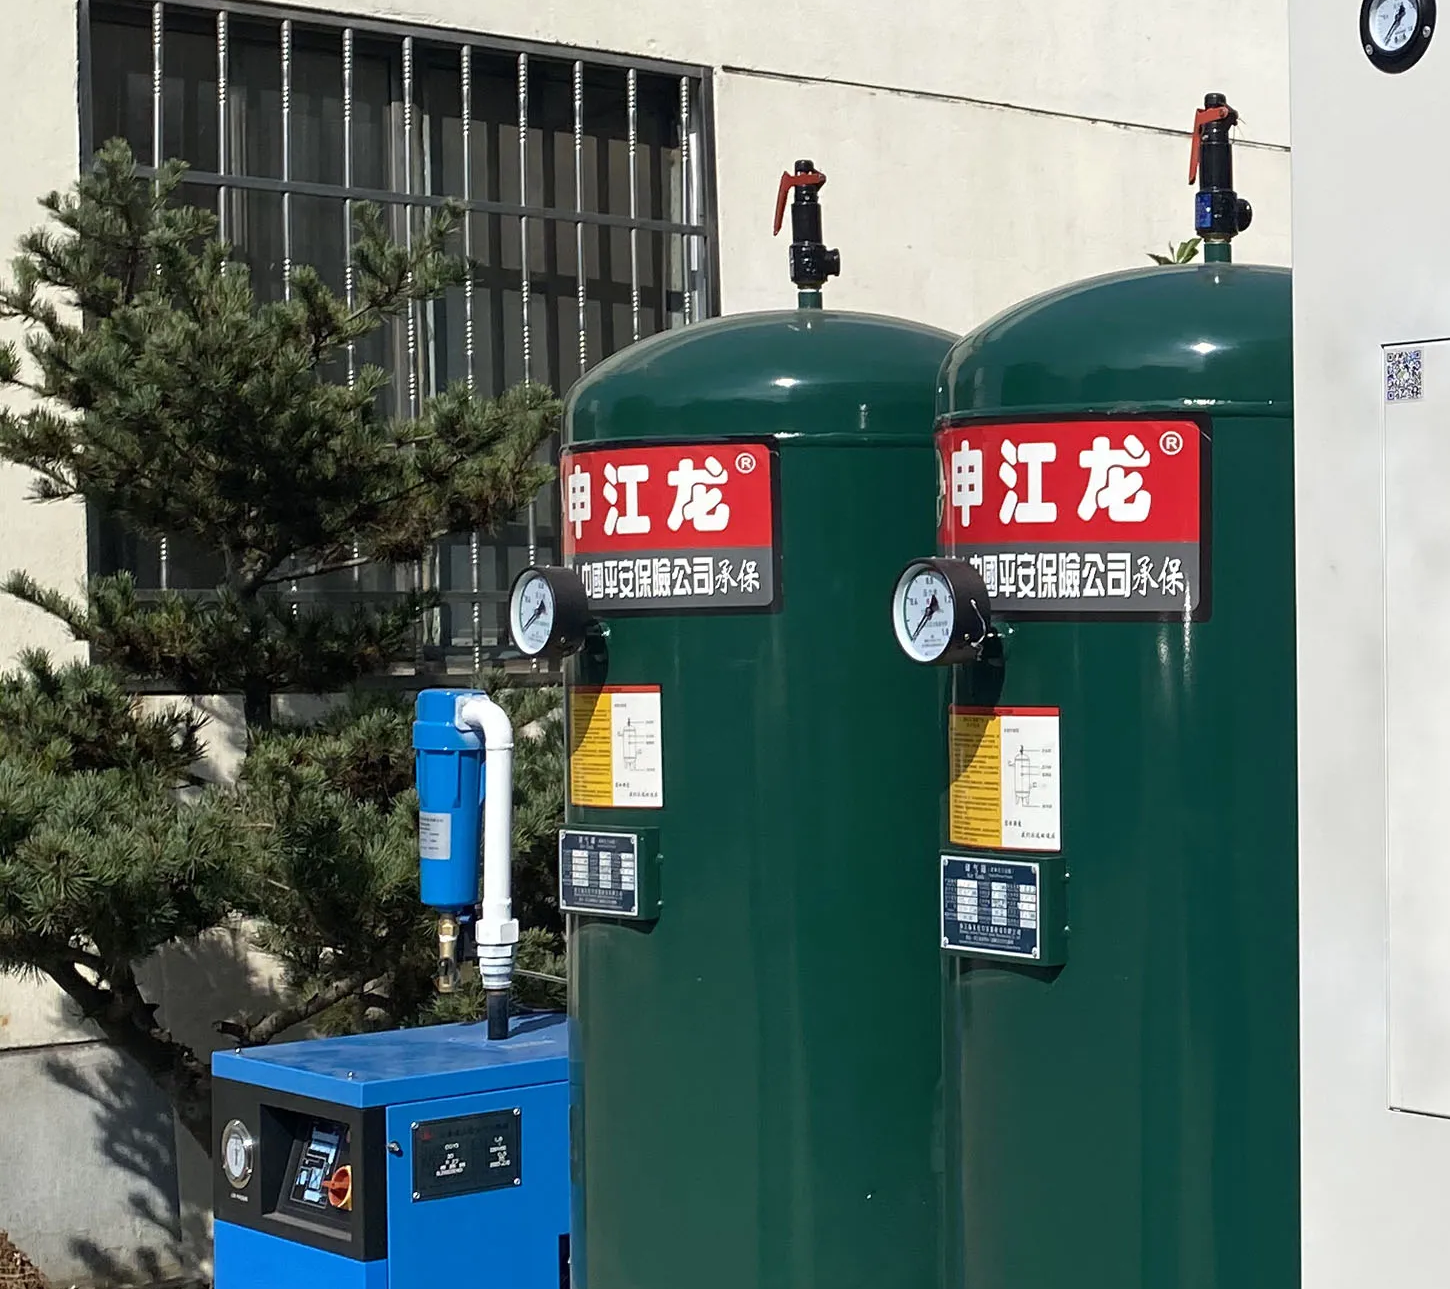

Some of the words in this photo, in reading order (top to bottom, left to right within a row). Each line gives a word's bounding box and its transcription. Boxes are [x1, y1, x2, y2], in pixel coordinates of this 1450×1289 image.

[568, 455, 730, 540] 申江龙
[952, 434, 1152, 527] 申江龙
